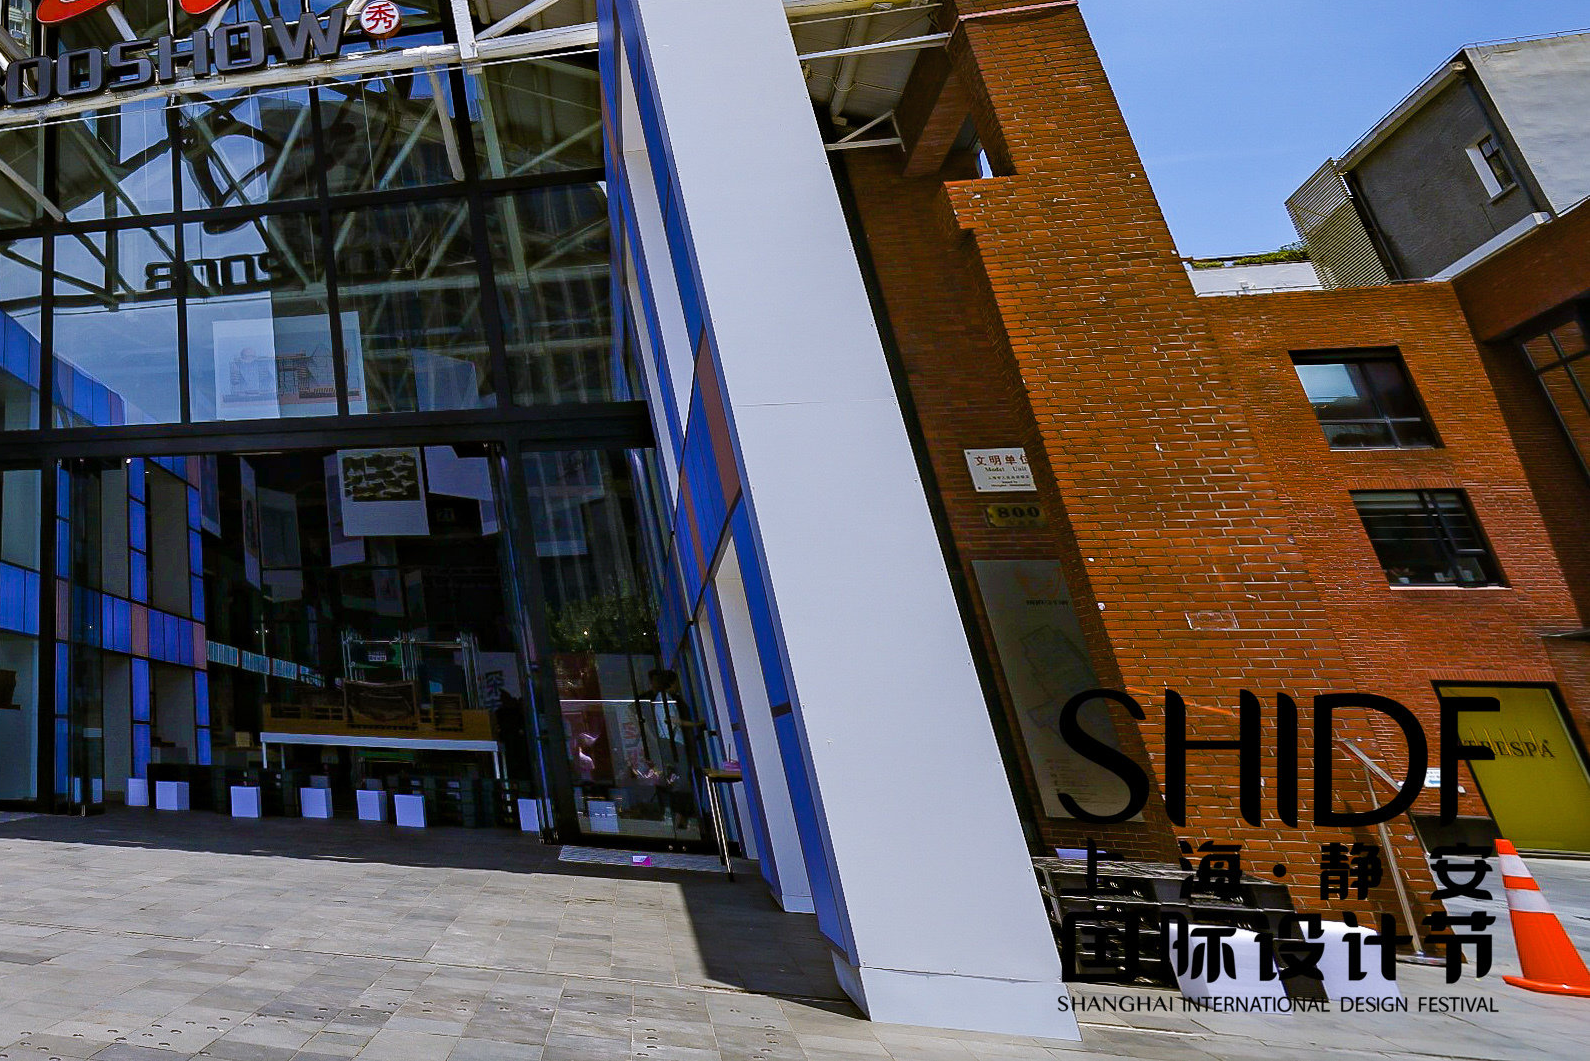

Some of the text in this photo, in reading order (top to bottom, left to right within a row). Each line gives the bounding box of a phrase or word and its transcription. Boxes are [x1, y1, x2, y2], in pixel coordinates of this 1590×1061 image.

[365, 2, 396, 32] 秀
[974, 454, 1028, 466] 文明单位
[998, 506, 1040, 518] 800
